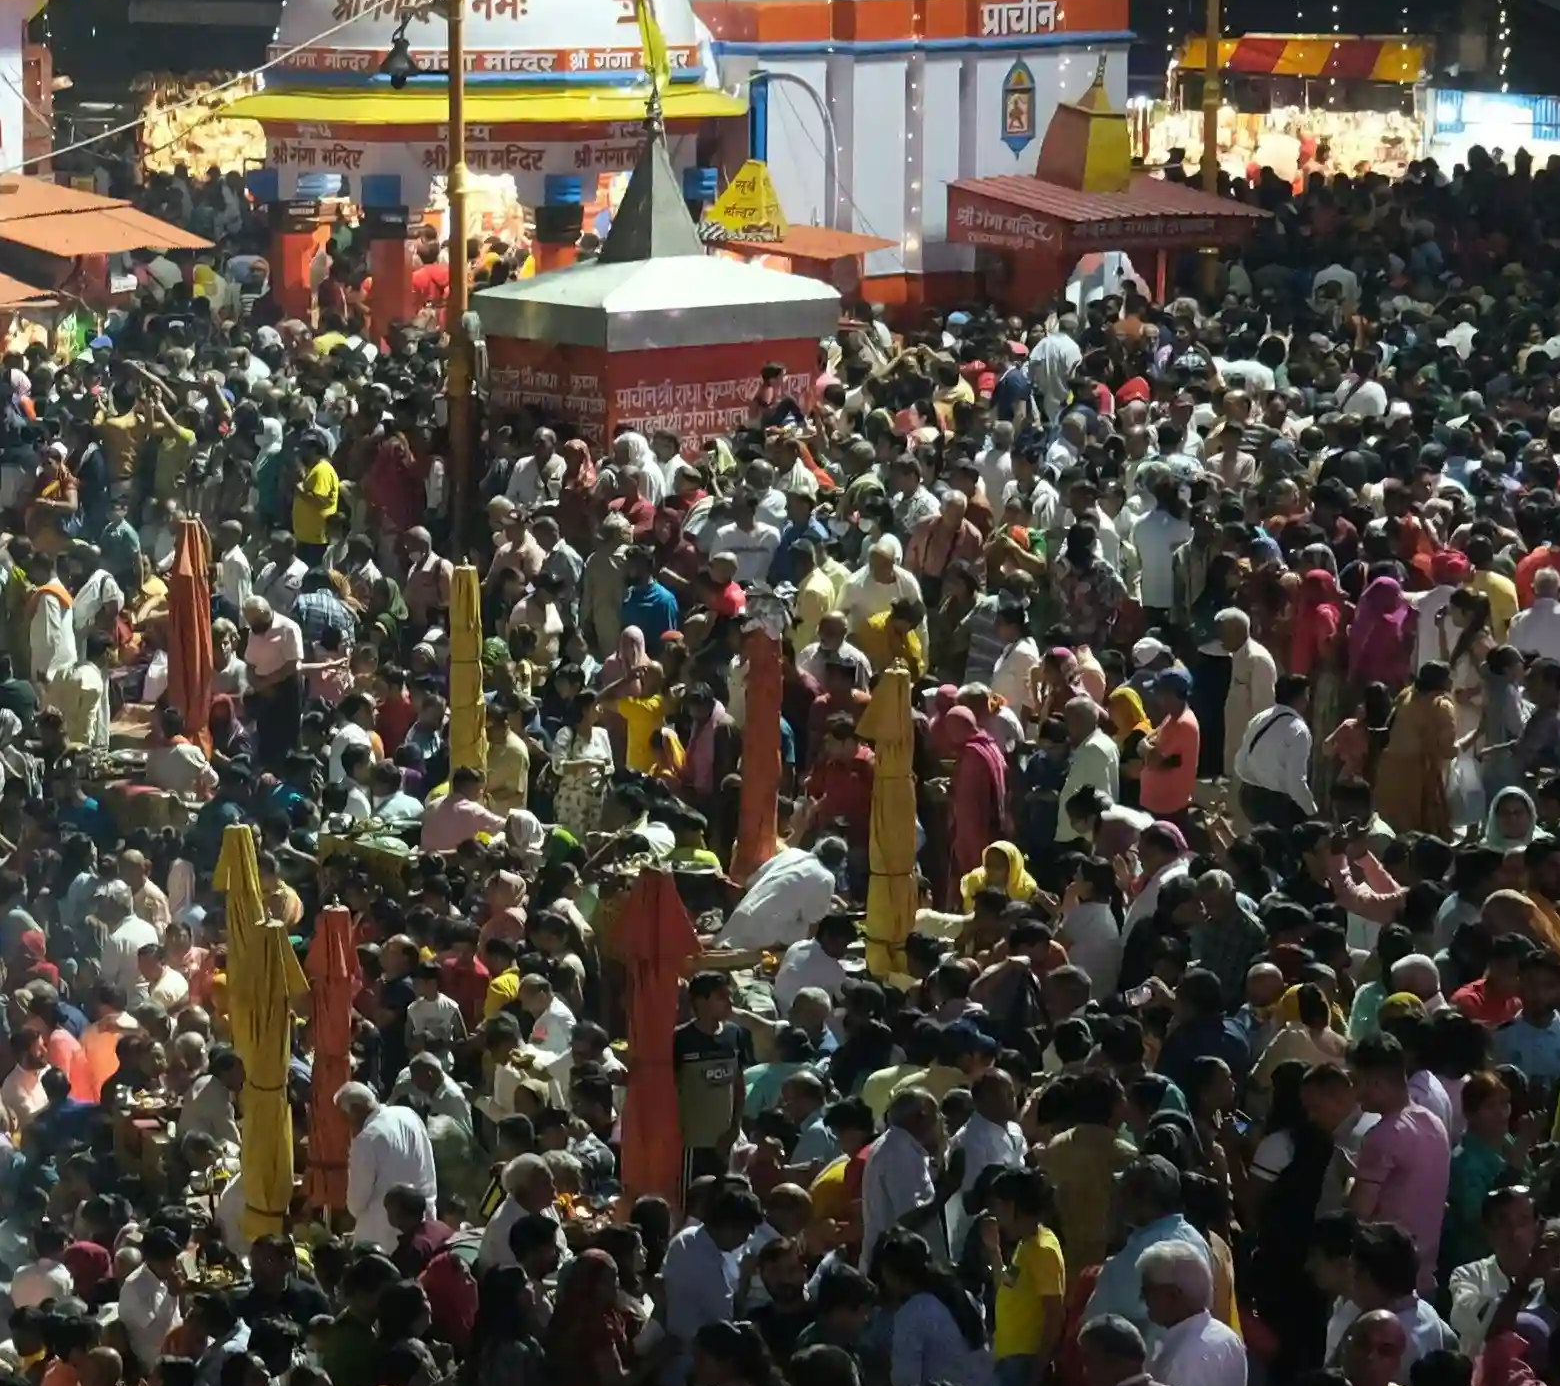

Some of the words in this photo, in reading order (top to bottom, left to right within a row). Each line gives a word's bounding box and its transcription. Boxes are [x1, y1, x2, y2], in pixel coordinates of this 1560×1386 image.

[482, 50, 558, 72] मन्दिर
[570, 49, 589, 71] श्री
[593, 47, 634, 70] गंगा
